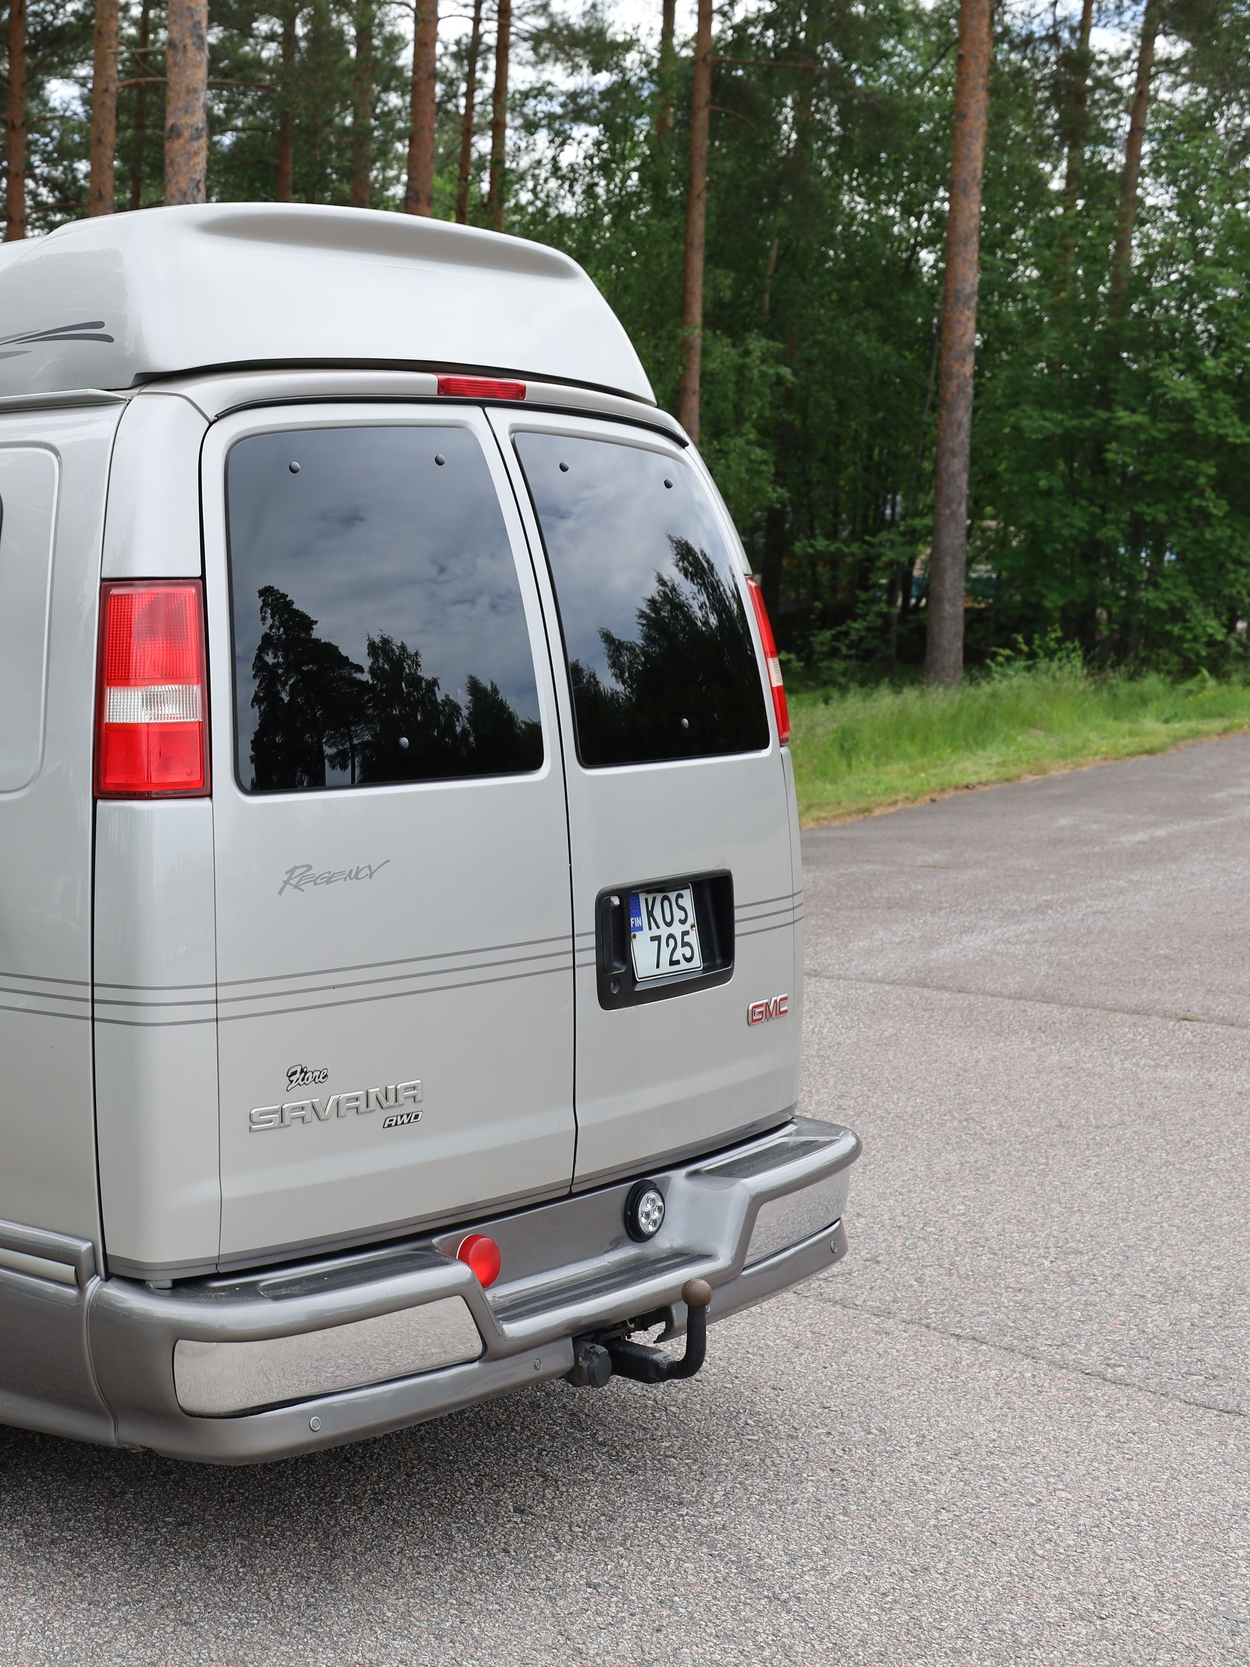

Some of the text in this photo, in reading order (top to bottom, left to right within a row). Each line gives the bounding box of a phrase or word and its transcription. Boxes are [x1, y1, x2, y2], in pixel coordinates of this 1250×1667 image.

[277, 859, 390, 896] REGENCY
[630, 916, 642, 928] FIN
[644, 892, 689, 931] KOS
[650, 930, 695, 969] 725
[747, 993, 789, 1026] GMC
[286, 1063, 329, 1092] Fiore
[249, 1079, 423, 1133] SAVANA
[382, 1110, 424, 1129] AWD
